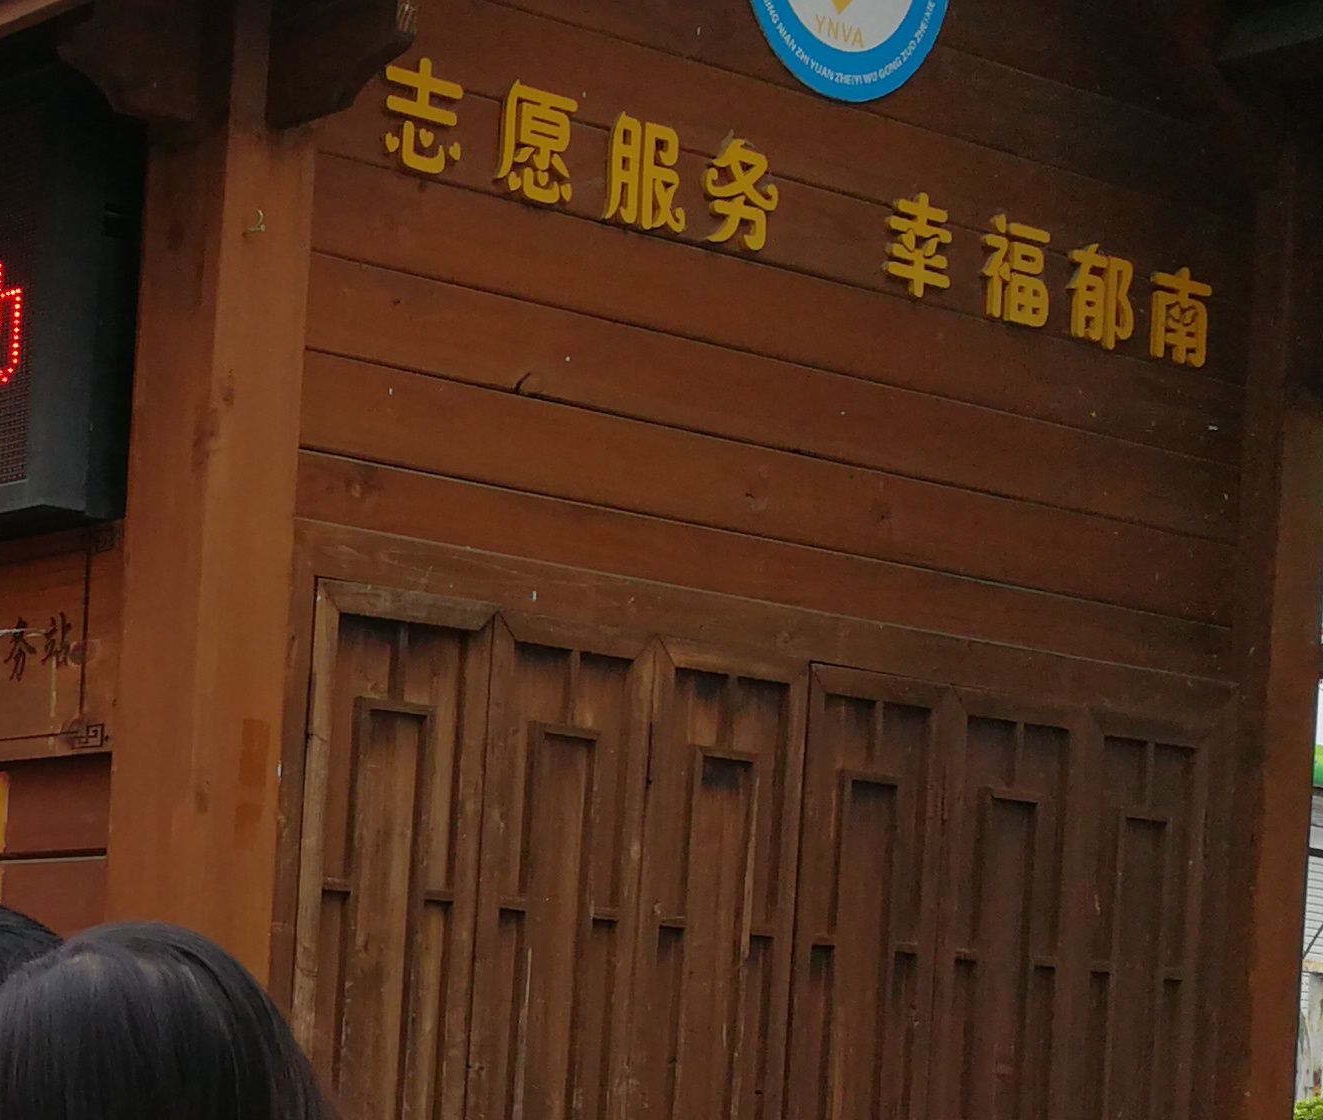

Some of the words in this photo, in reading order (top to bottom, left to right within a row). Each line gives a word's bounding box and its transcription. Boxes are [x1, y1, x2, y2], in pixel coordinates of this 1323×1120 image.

[816, 14, 864, 48] YNVA
[385, 57, 779, 252] 志愿服务
[883, 192, 1214, 368] 幸福郁南
